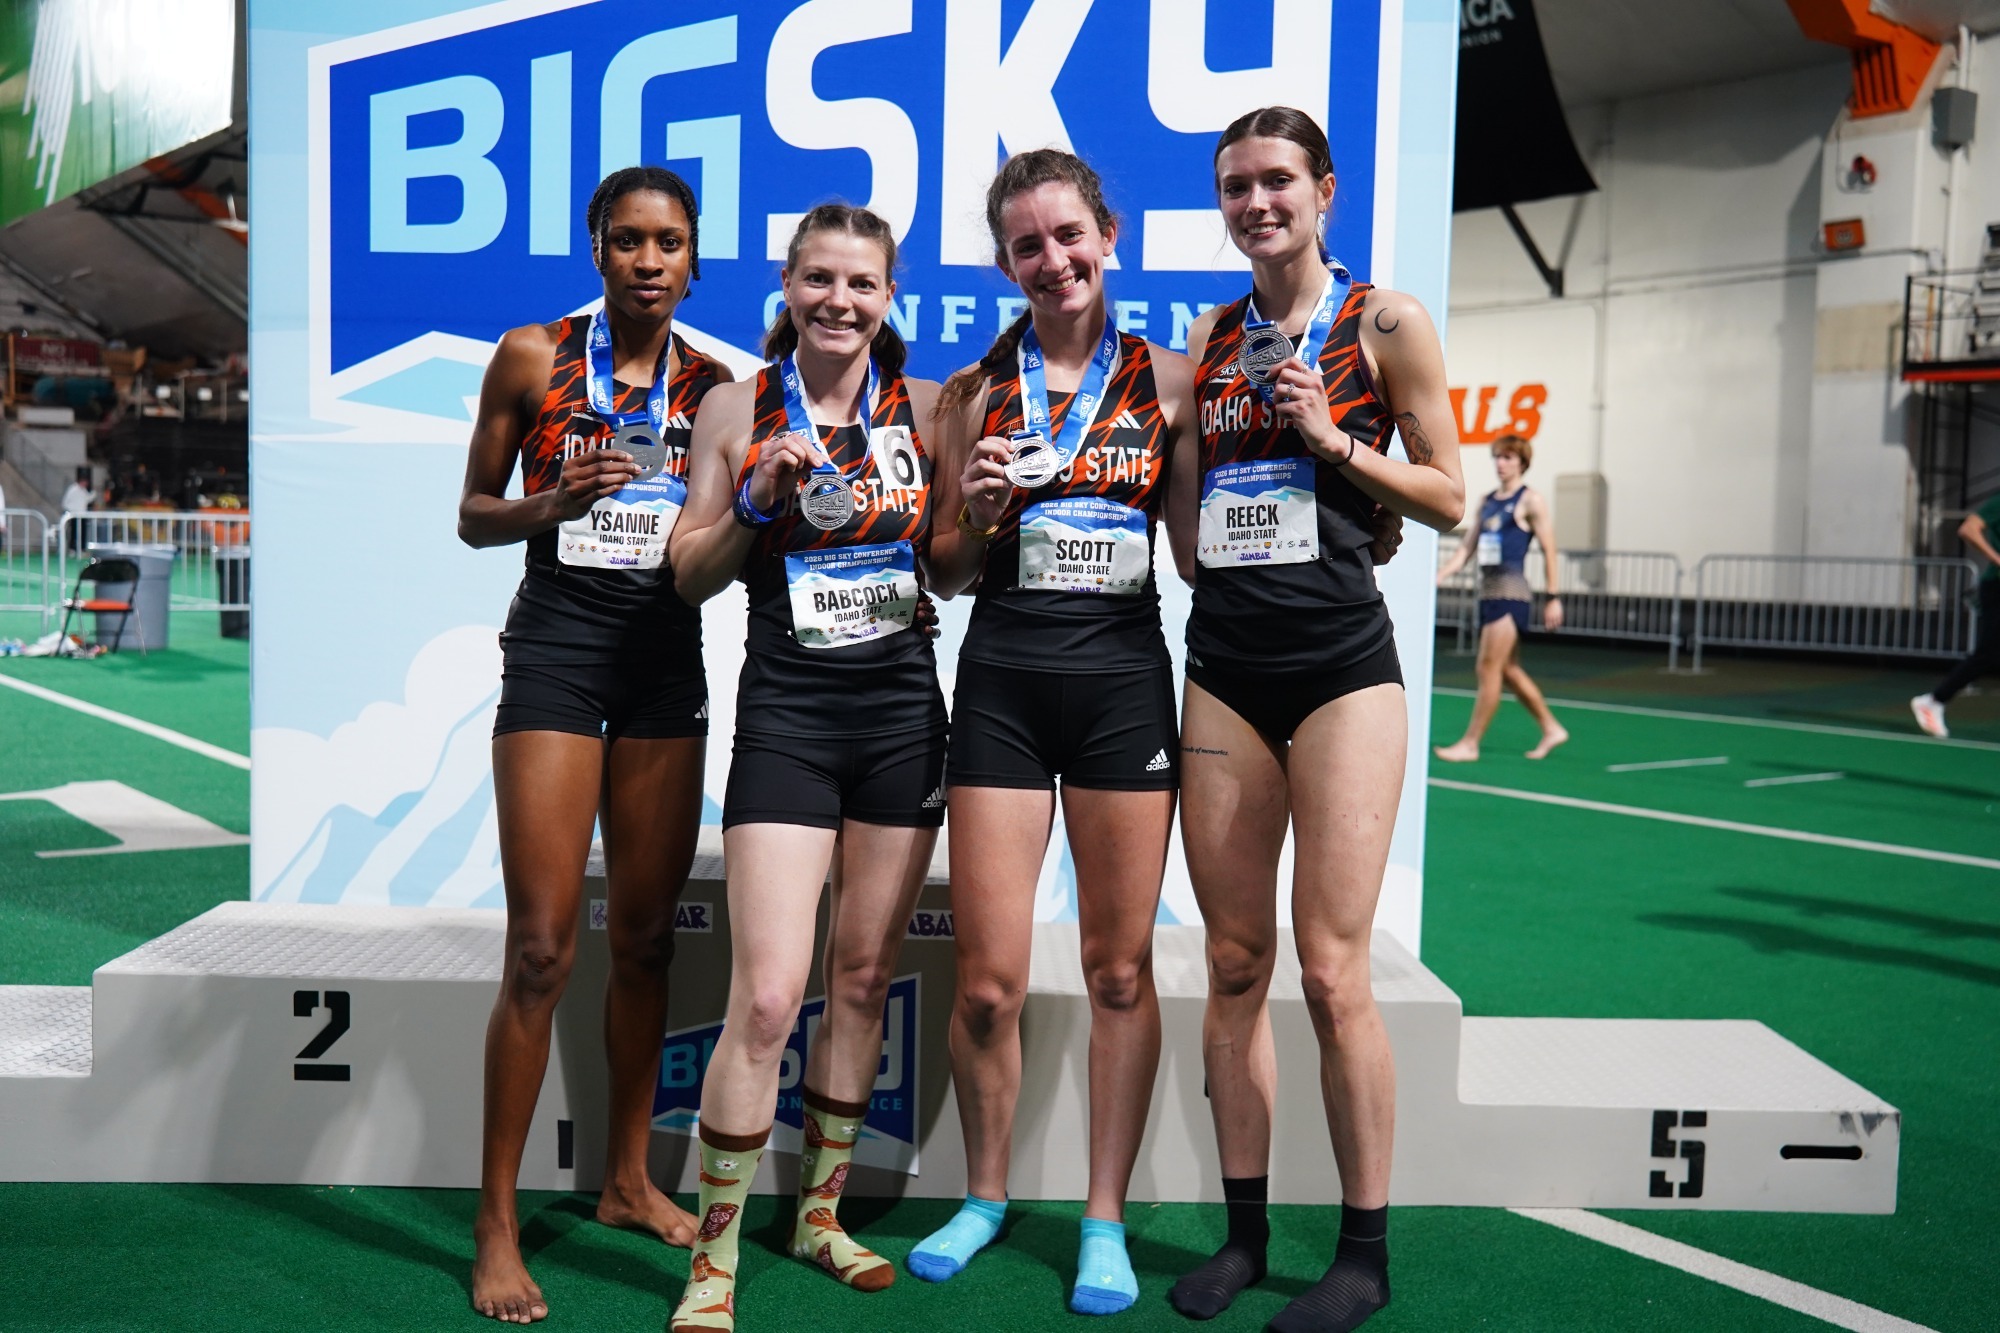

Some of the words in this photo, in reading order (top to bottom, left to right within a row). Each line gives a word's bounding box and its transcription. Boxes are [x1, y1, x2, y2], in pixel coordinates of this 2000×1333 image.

[573, 404, 591, 412] BIGS
[1201, 395, 1252, 436] IDAHO
[884, 429, 915, 487] 6
[1086, 446, 1151, 485] STATE
[1252, 463, 1297, 472] CONFERENCE
[1217, 478, 1237, 486] INDOOR
[1238, 472, 1292, 483] CHAMPIONSHIPS
[852, 478, 919, 515] STATE
[1090, 502, 1131, 513] CONFERENCE
[590, 510, 660, 535] YSANNE
[1073, 510, 1127, 521] CHAMPIONSHIPS
[1226, 504, 1279, 528] REECK
[599, 534, 624, 545] IDAHO
[627, 536, 648, 546] STATE
[1228, 530, 1251, 541] IDAHO
[1254, 528, 1277, 539] STATE
[804, 555, 822, 563] 2026
[838, 552, 852, 560] SKY
[853, 547, 898, 559] CONFERENCE
[1056, 539, 1115, 562] SCOTT
[1240, 552, 1271, 560] JAMBAR
[610, 556, 638, 565] JAMBAR
[809, 562, 836, 571] INDOOR
[838, 556, 893, 568] CHAMPIONSHIPS
[1058, 563, 1084, 574] IDAHO
[1087, 565, 1110, 575] STATE
[813, 582, 900, 613] BABCOCK
[834, 610, 860, 623] IDAHO
[861, 606, 882, 618] STATE
[1146, 761, 1170, 771] adidas
[922, 800, 942, 808] adidas
[293, 990, 350, 1081] 2
[1649, 1110, 1707, 1198] 5
